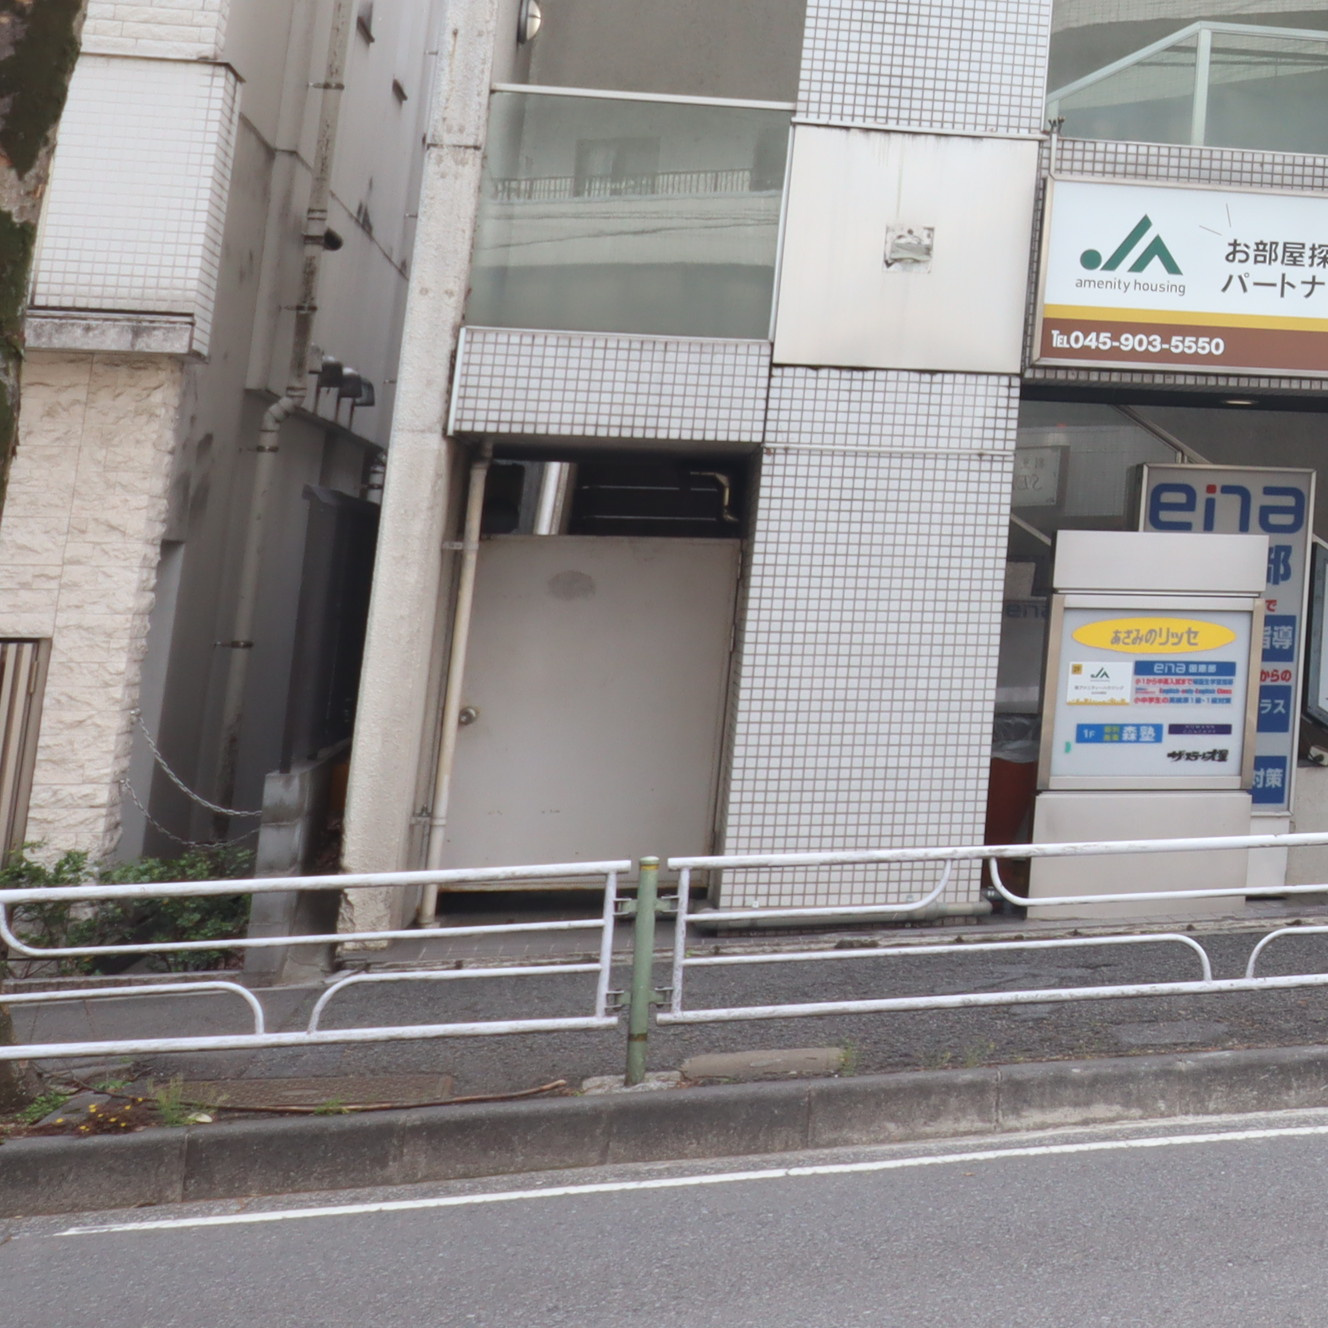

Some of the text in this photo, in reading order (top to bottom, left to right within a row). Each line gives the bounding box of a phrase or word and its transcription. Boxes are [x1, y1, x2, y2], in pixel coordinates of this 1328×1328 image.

[1075, 277, 1187, 297] amenity housing
[1148, 482, 1306, 533] ena
[1111, 627, 1200, 646] あざみのリッセ
[1153, 663, 1186, 673] ena
[1122, 725, 1155, 742] 森塾
